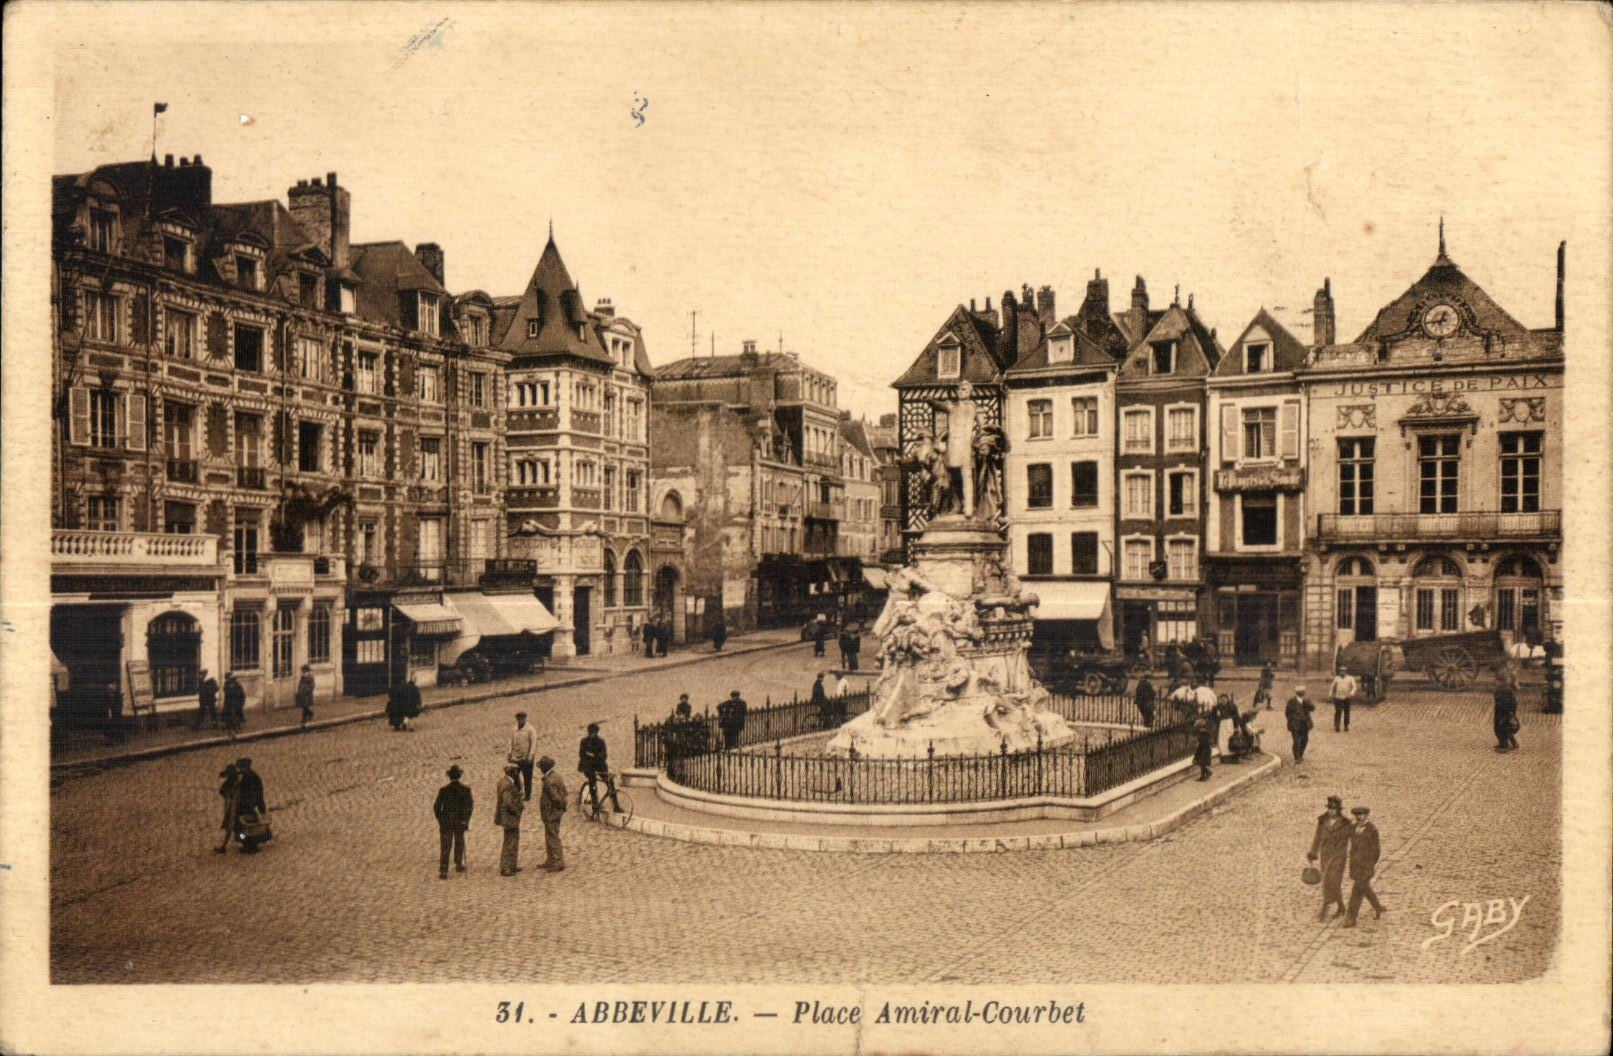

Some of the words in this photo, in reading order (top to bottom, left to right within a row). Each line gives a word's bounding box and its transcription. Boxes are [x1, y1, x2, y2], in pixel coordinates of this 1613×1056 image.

[1334, 379, 1443, 396] JUSTICE
[1453, 379, 1478, 392] DE
[1489, 373, 1549, 389] PAIX
